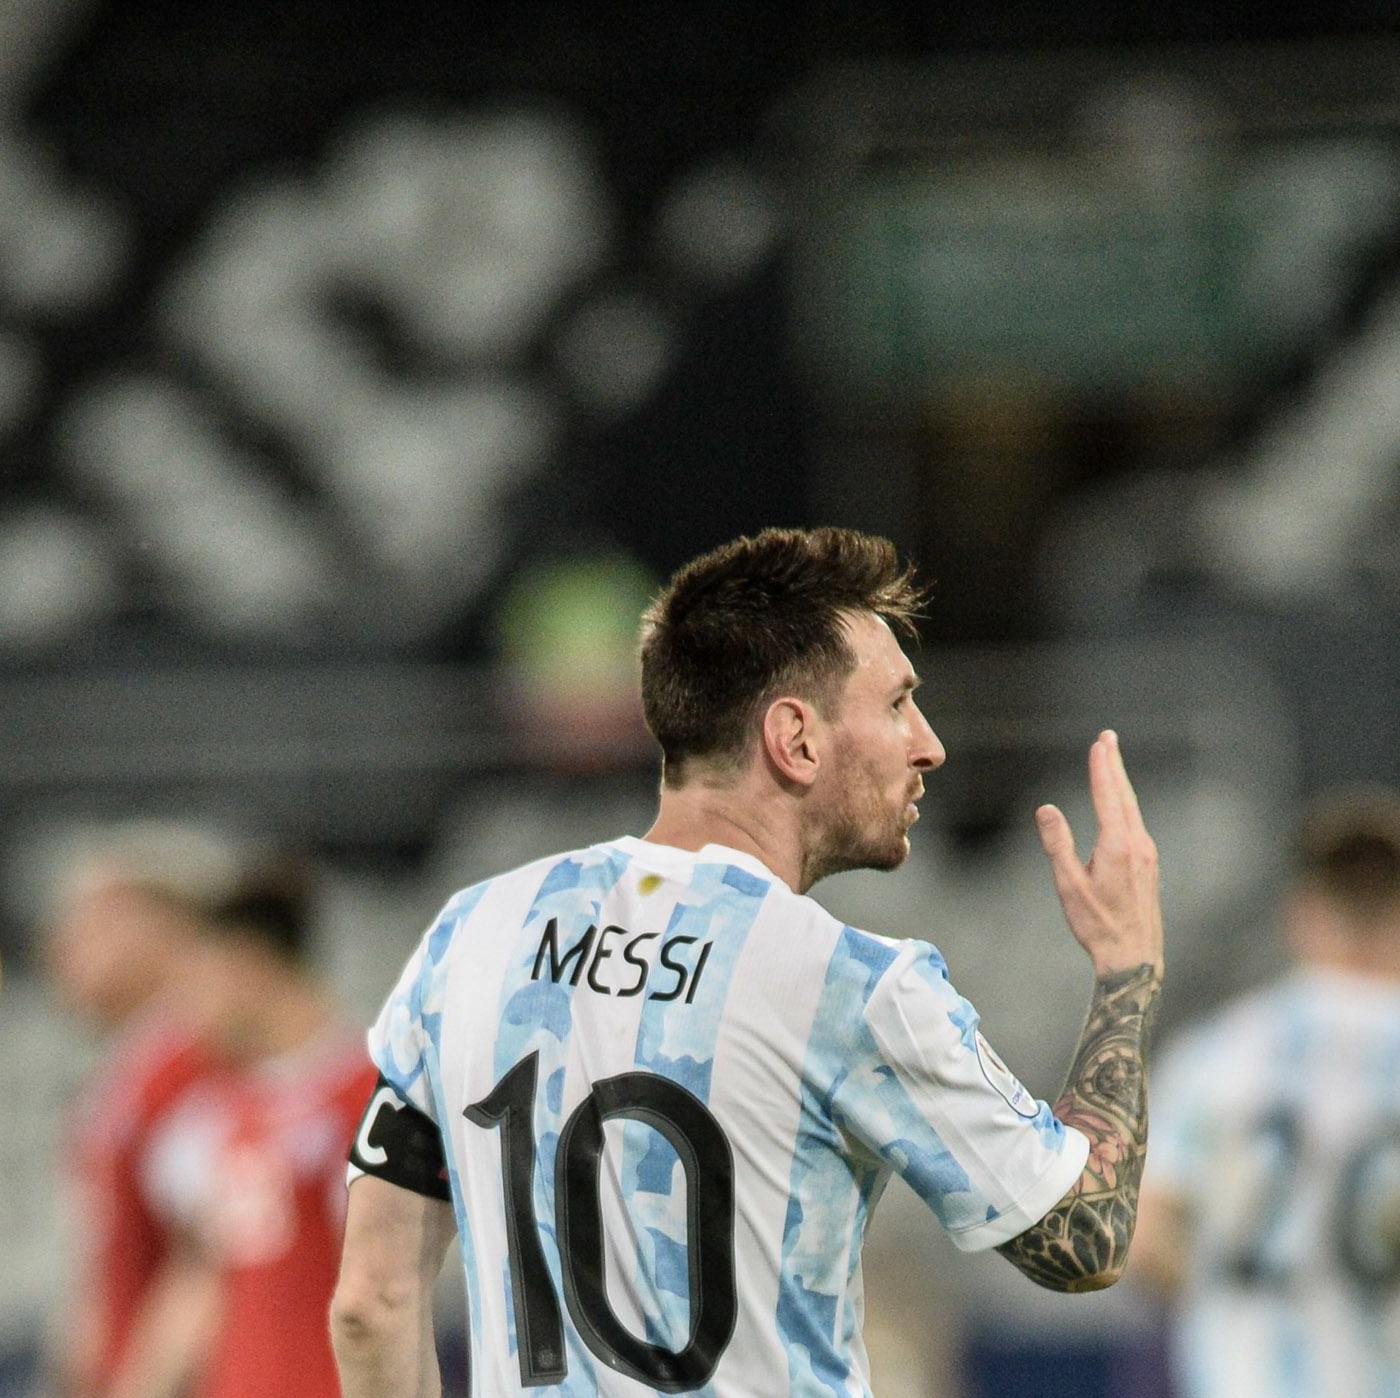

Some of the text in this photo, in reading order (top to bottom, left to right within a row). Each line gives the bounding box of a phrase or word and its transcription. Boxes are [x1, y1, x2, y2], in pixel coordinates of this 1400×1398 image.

[530, 917, 714, 1004] MESSI
[357, 1086, 407, 1165] C
[462, 1049, 738, 1394] 10
